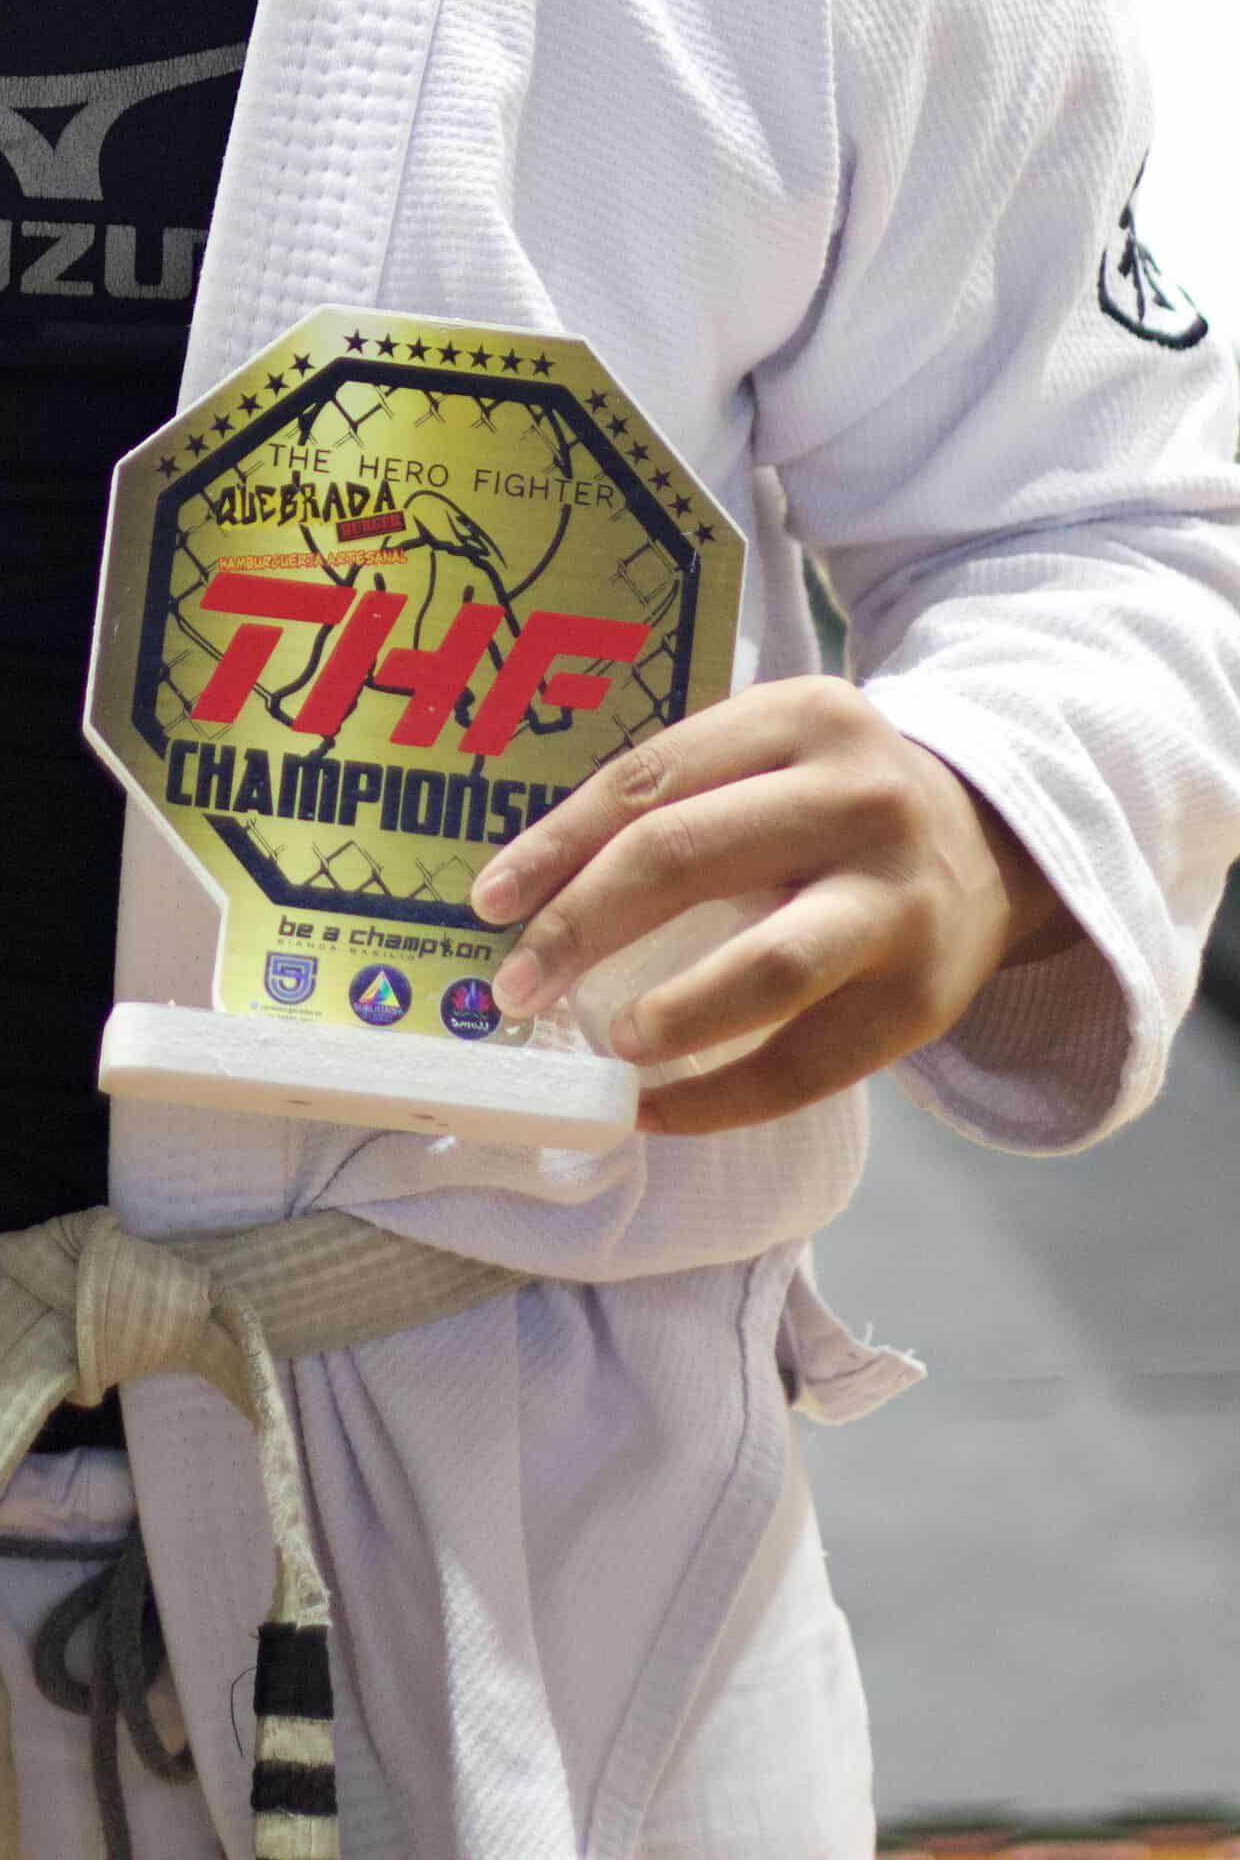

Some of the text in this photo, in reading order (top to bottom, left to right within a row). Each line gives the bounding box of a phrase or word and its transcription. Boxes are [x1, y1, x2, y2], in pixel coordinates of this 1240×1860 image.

[216, 478, 397, 527] QUEBRADA
[268, 443, 616, 509] THE HERO FIGHTER
[219, 548, 409, 571] HAMBURGUERIA ARTESANAL
[189, 571, 653, 757] THF
[165, 738, 575, 846] CHAMPIONSH
[277, 914, 314, 940] be
[322, 925, 341, 942] a
